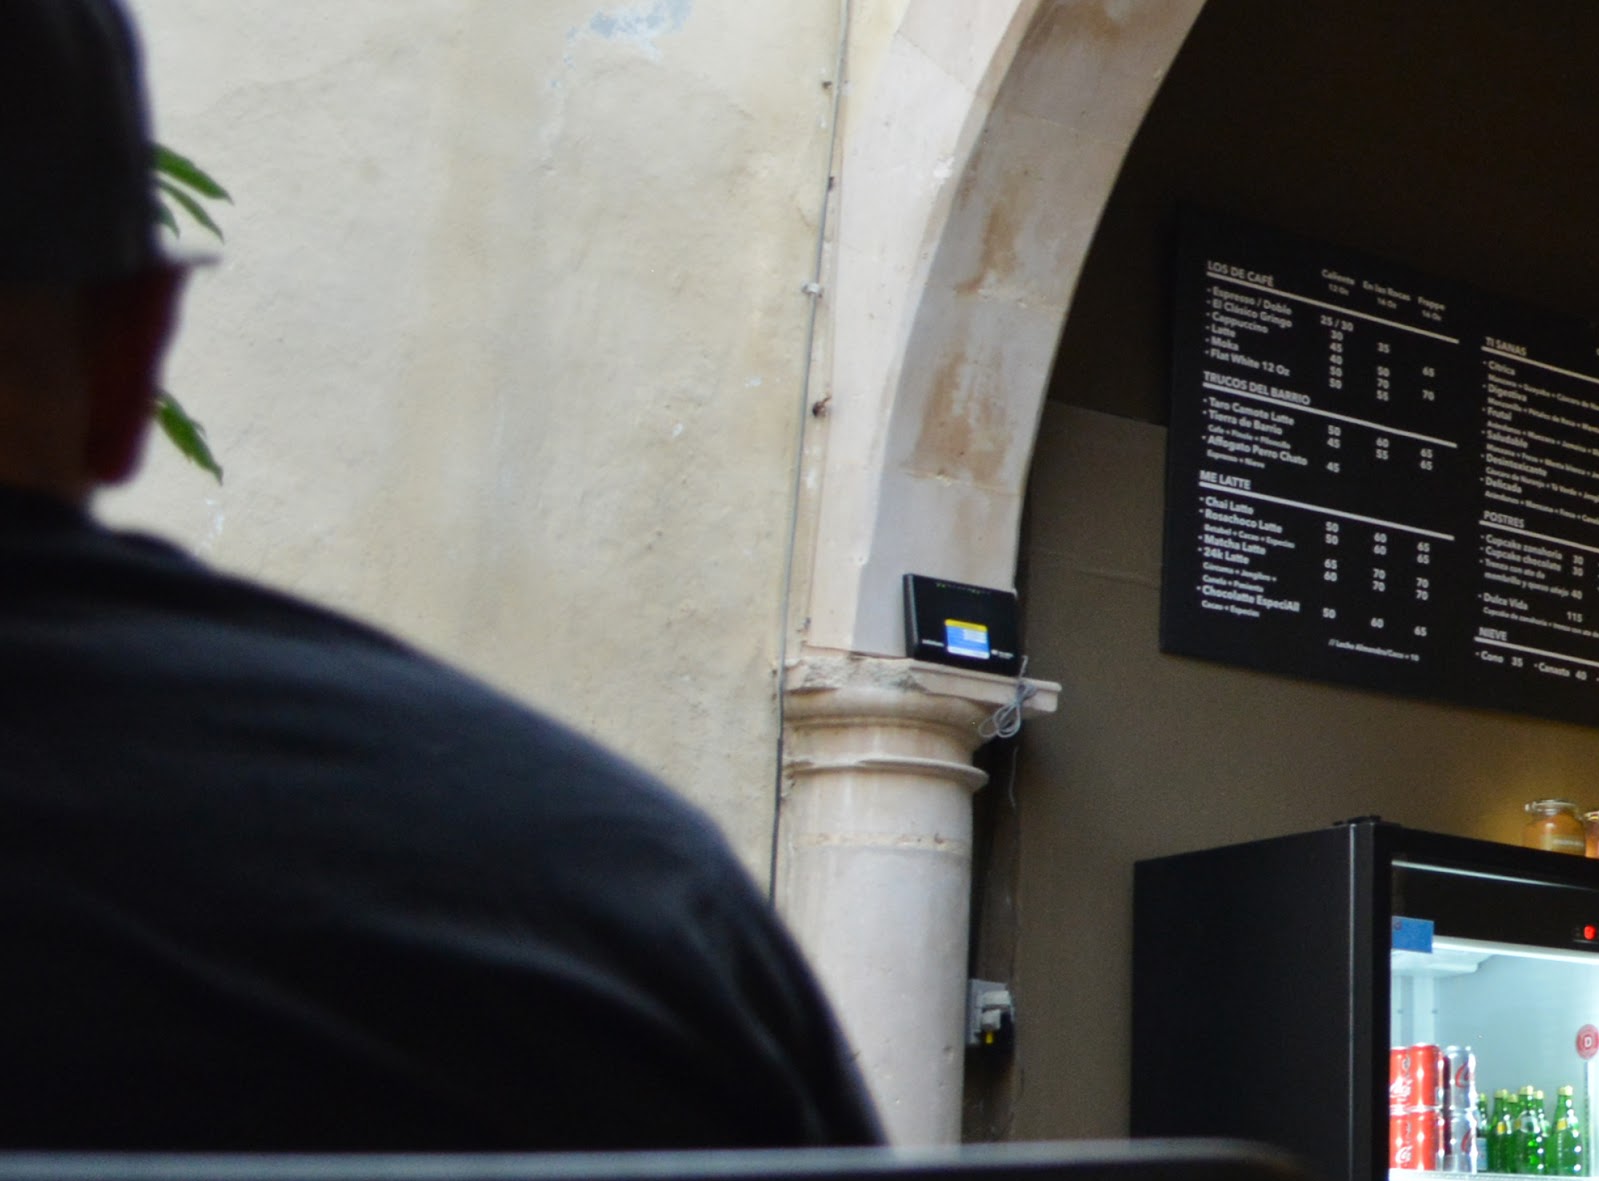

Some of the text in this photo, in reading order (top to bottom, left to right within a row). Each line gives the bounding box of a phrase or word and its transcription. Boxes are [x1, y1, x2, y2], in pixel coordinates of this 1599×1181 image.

[1247, 271, 1273, 287] CAFÉ
[1211, 311, 1268, 333] Cappuccino
[1211, 323, 1236, 337] Latte
[1210, 336, 1239, 351] Moka
[1210, 348, 1229, 361] Flat
[1230, 353, 1260, 368] White
[1270, 387, 1310, 405] BARRIO
[1270, 411, 1294, 425] Latte
[1219, 474, 1250, 490] LATTE
[1229, 501, 1254, 515] Latte
[1258, 520, 1282, 533] Latte
[1483, 510, 1524, 528] POSTRES
[1241, 541, 1266, 555] Latte
[1224, 551, 1249, 564] Latte
